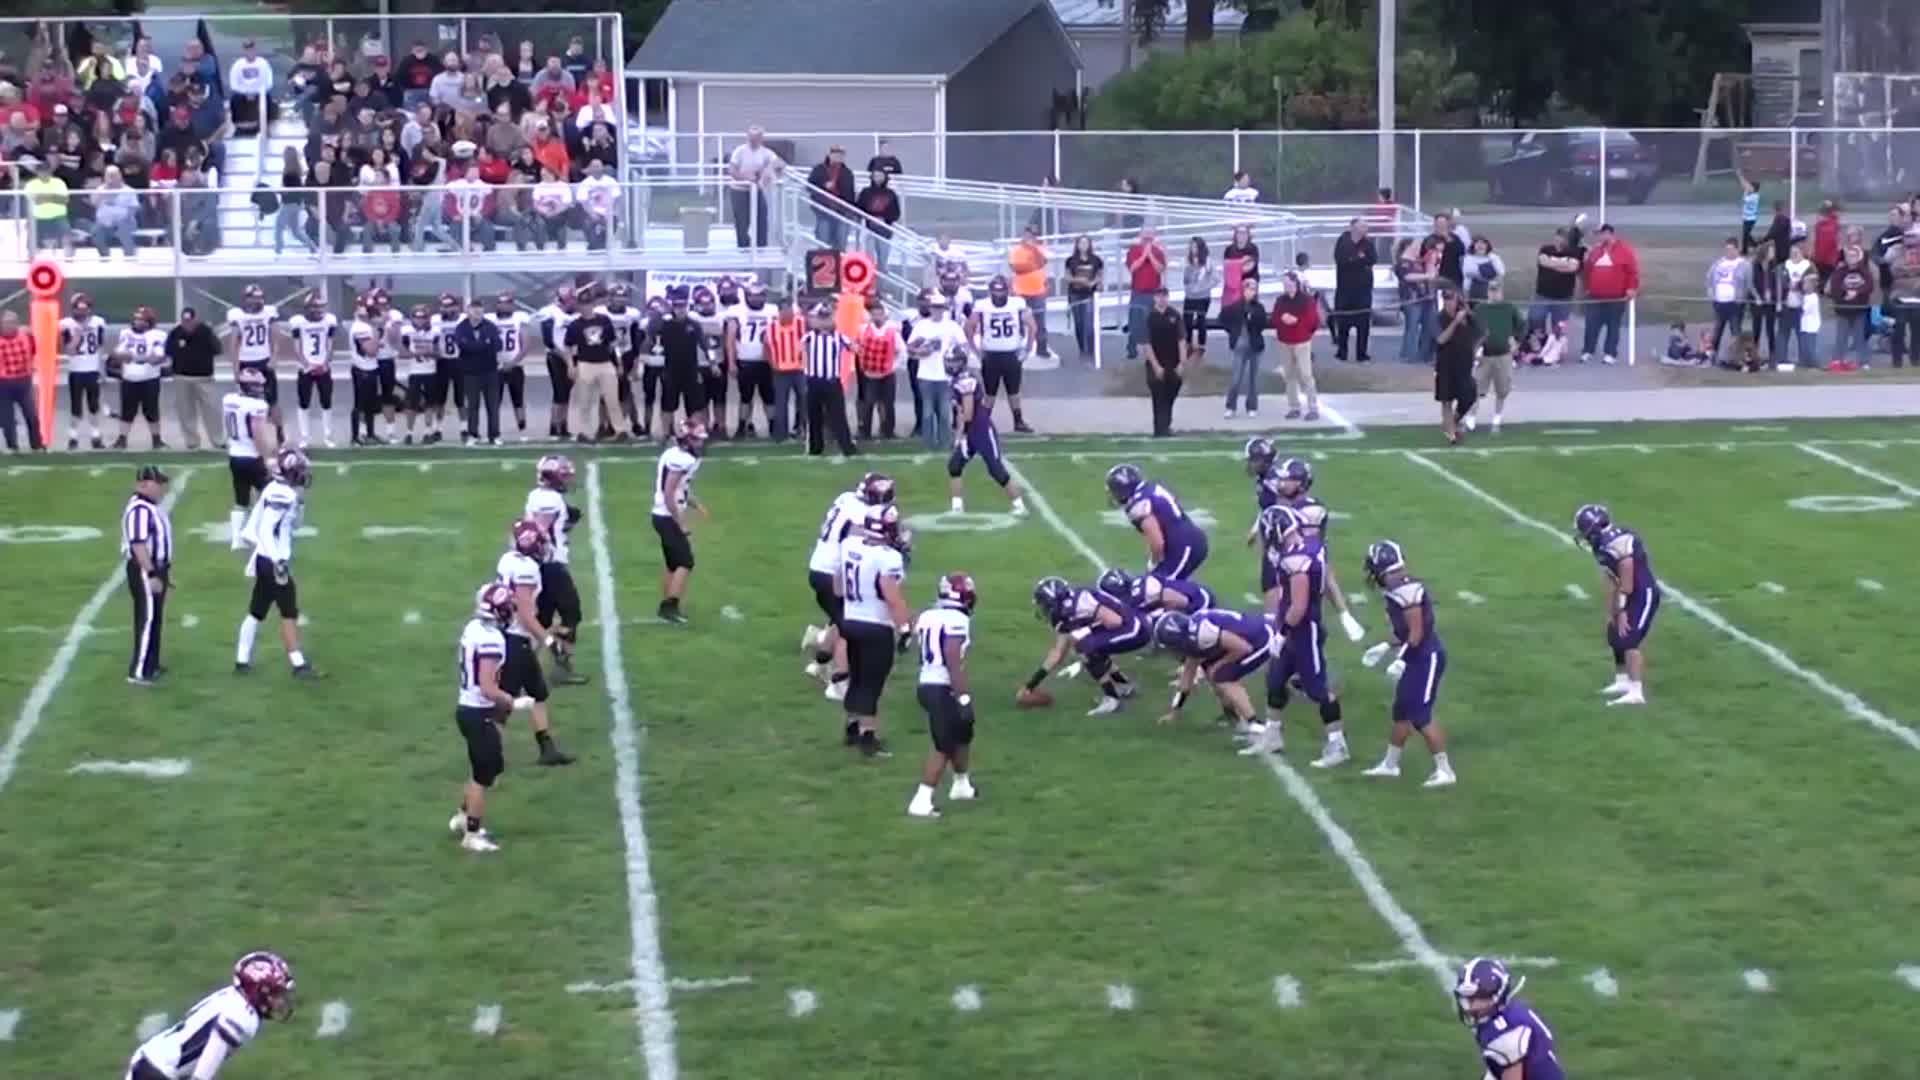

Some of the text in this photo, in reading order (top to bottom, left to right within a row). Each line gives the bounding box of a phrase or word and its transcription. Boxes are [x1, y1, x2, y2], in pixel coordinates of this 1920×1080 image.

[811, 254, 837, 289] 2
[244, 323, 267, 346] 20
[990, 319, 1014, 338] 56
[75, 331, 98, 355] 28
[309, 333, 321, 355] 3
